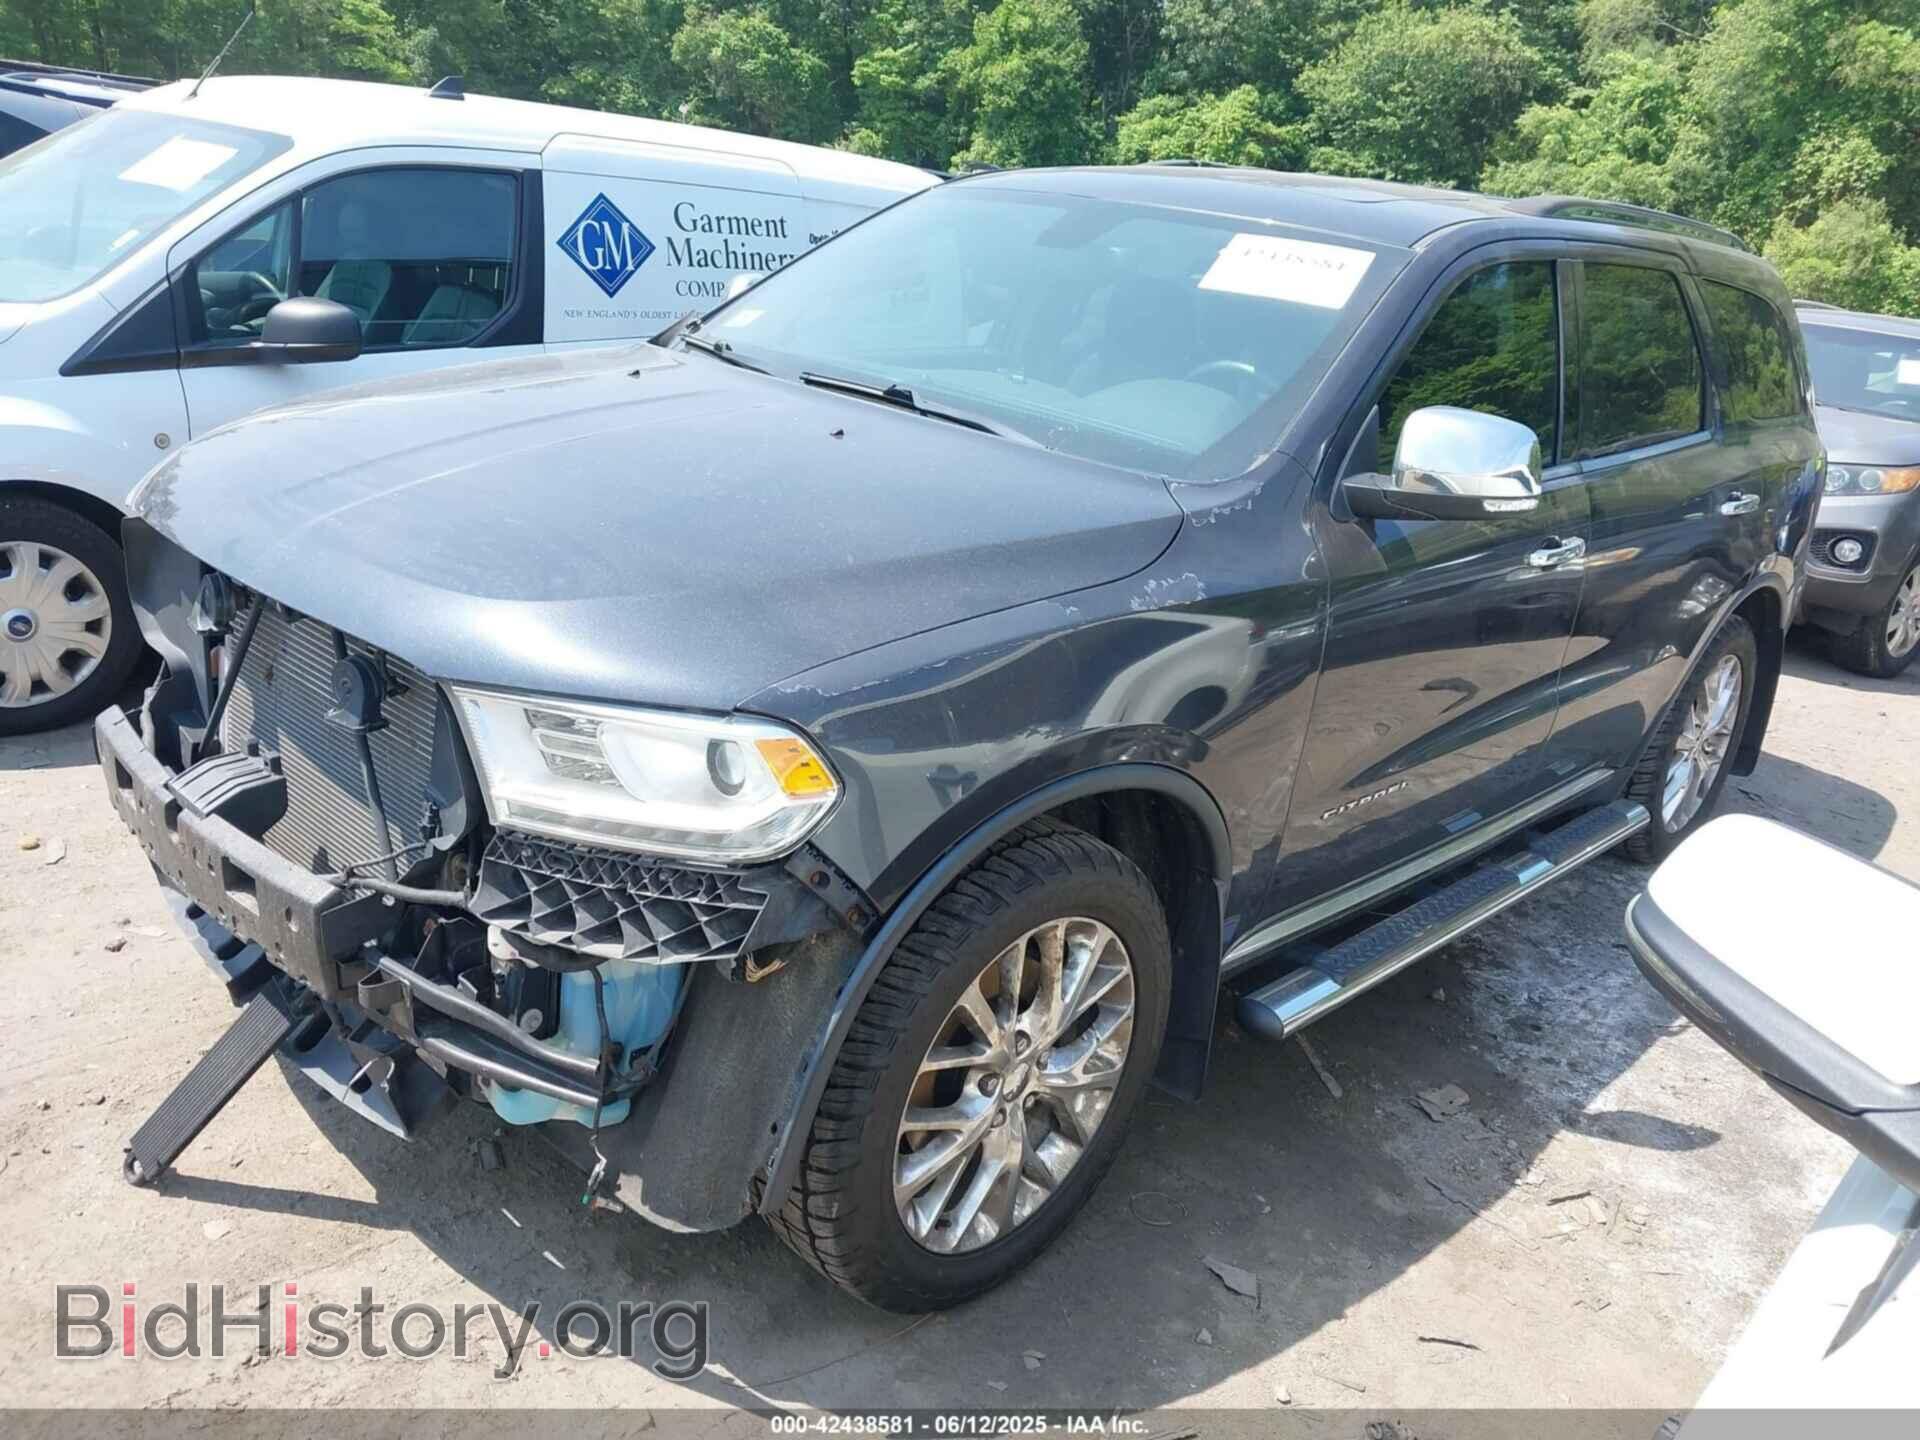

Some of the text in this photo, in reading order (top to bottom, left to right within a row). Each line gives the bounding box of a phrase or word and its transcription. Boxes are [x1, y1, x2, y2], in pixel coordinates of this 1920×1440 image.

[673, 201, 787, 238] Garment
[577, 219, 635, 270] GM
[664, 236, 795, 271] Machiner
[675, 279, 726, 297] COMP
[563, 309, 583, 319] NEW
[586, 309, 638, 319] ENGLAND'S
[640, 310, 672, 320] OLDEST
